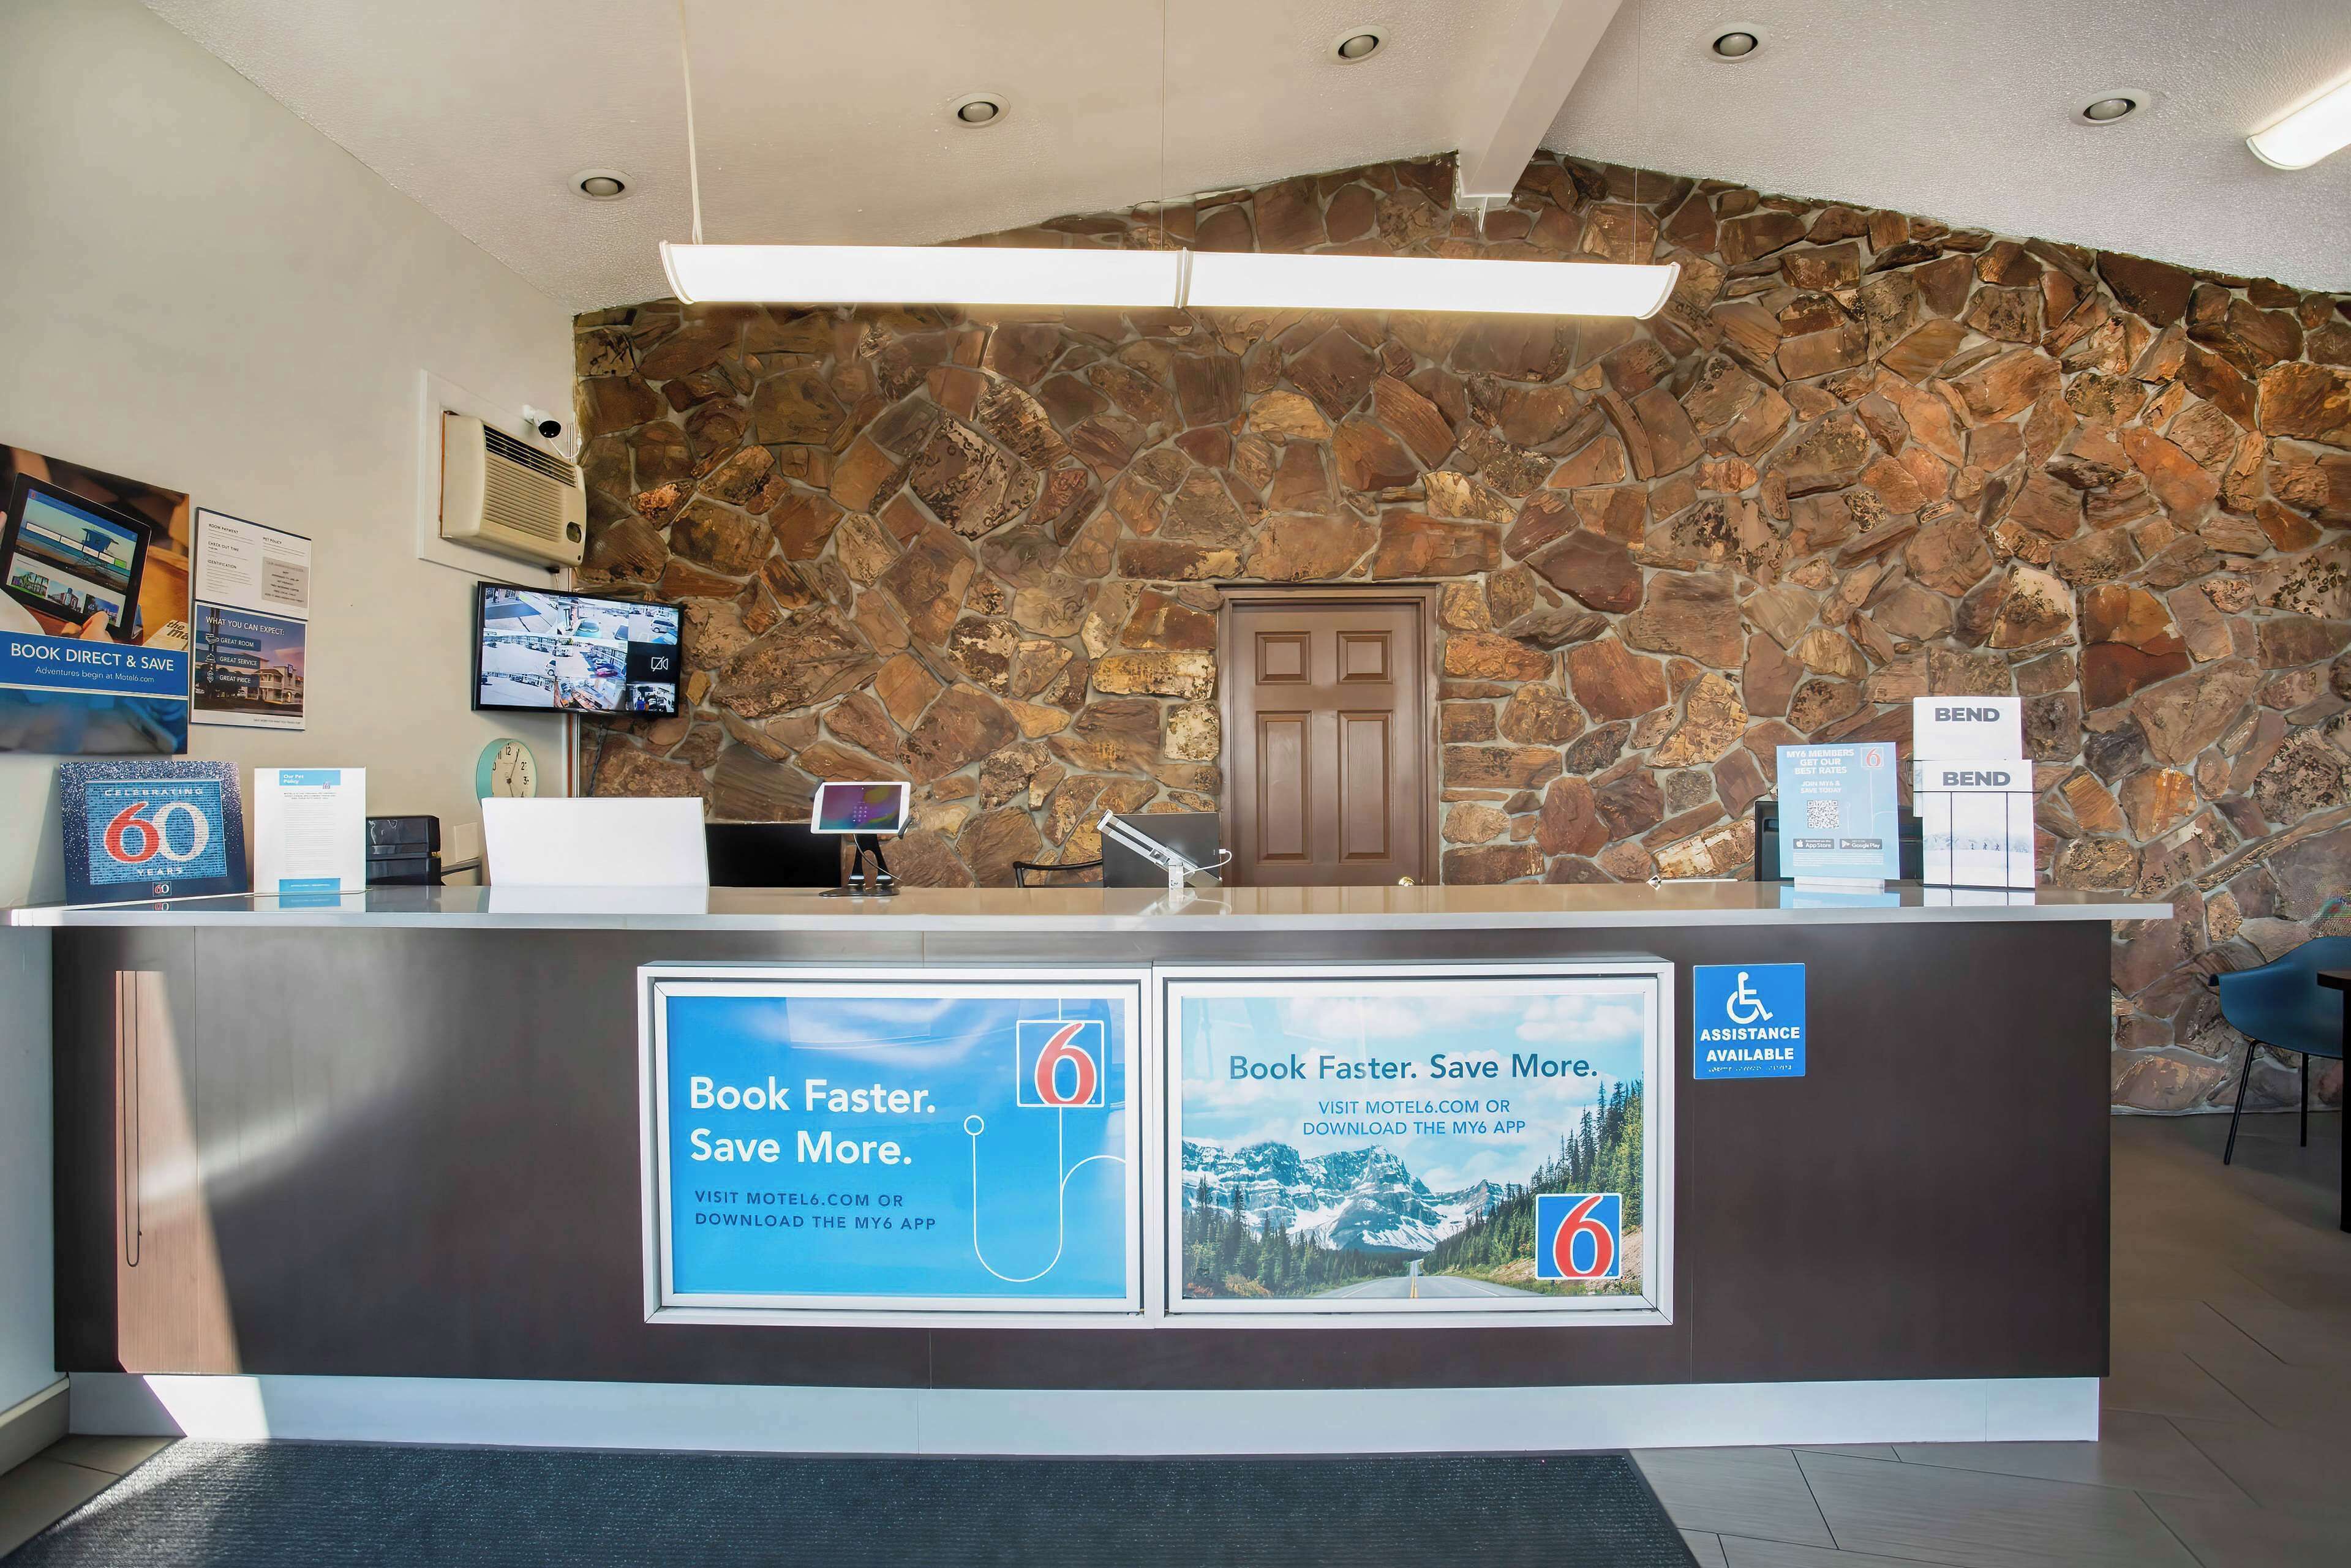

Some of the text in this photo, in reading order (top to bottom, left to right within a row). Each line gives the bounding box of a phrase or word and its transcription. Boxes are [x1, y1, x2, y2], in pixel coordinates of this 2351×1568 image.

[167, 621, 185, 631] the
[206, 616, 227, 626] WHAT
[244, 623, 258, 631] CAN
[260, 626, 284, 636] EXPECT:
[11, 643, 174, 672] BOOK DIRECT & SAVE
[36, 666, 80, 677] Adventures
[82, 670, 103, 680] begin
[115, 673, 154, 683] Motel6.com
[1935, 707, 2000, 722] BEND
[506, 746, 511, 756] 12
[1866, 748, 1881, 767] 6
[521, 762, 525, 770] 2
[523, 776, 527, 785] 3
[1943, 771, 2011, 786] BEND
[104, 801, 209, 864] 60
[137, 867, 183, 876] YEARS
[154, 884, 169, 894] 60
[1700, 1027, 1800, 1041] ASSISTANCE
[1706, 1048, 1794, 1062] AVAILABLE
[1034, 1022, 1097, 1106] 6
[1230, 1053, 1598, 1080] Book Faster. Save More.
[691, 1076, 936, 1114] Book Faster.
[1318, 1099, 1510, 1114] VISIT MOTEL6.COM OR
[1303, 1120, 1526, 1135] DOWNLOAD THE MY6 APP
[690, 1128, 912, 1165] Save More.
[694, 1190, 903, 1207] VISIT MOTEL6.COM OR
[695, 1213, 936, 1231] DOWNLOAD THE MY6 APP
[1553, 1195, 1614, 1277] 6
